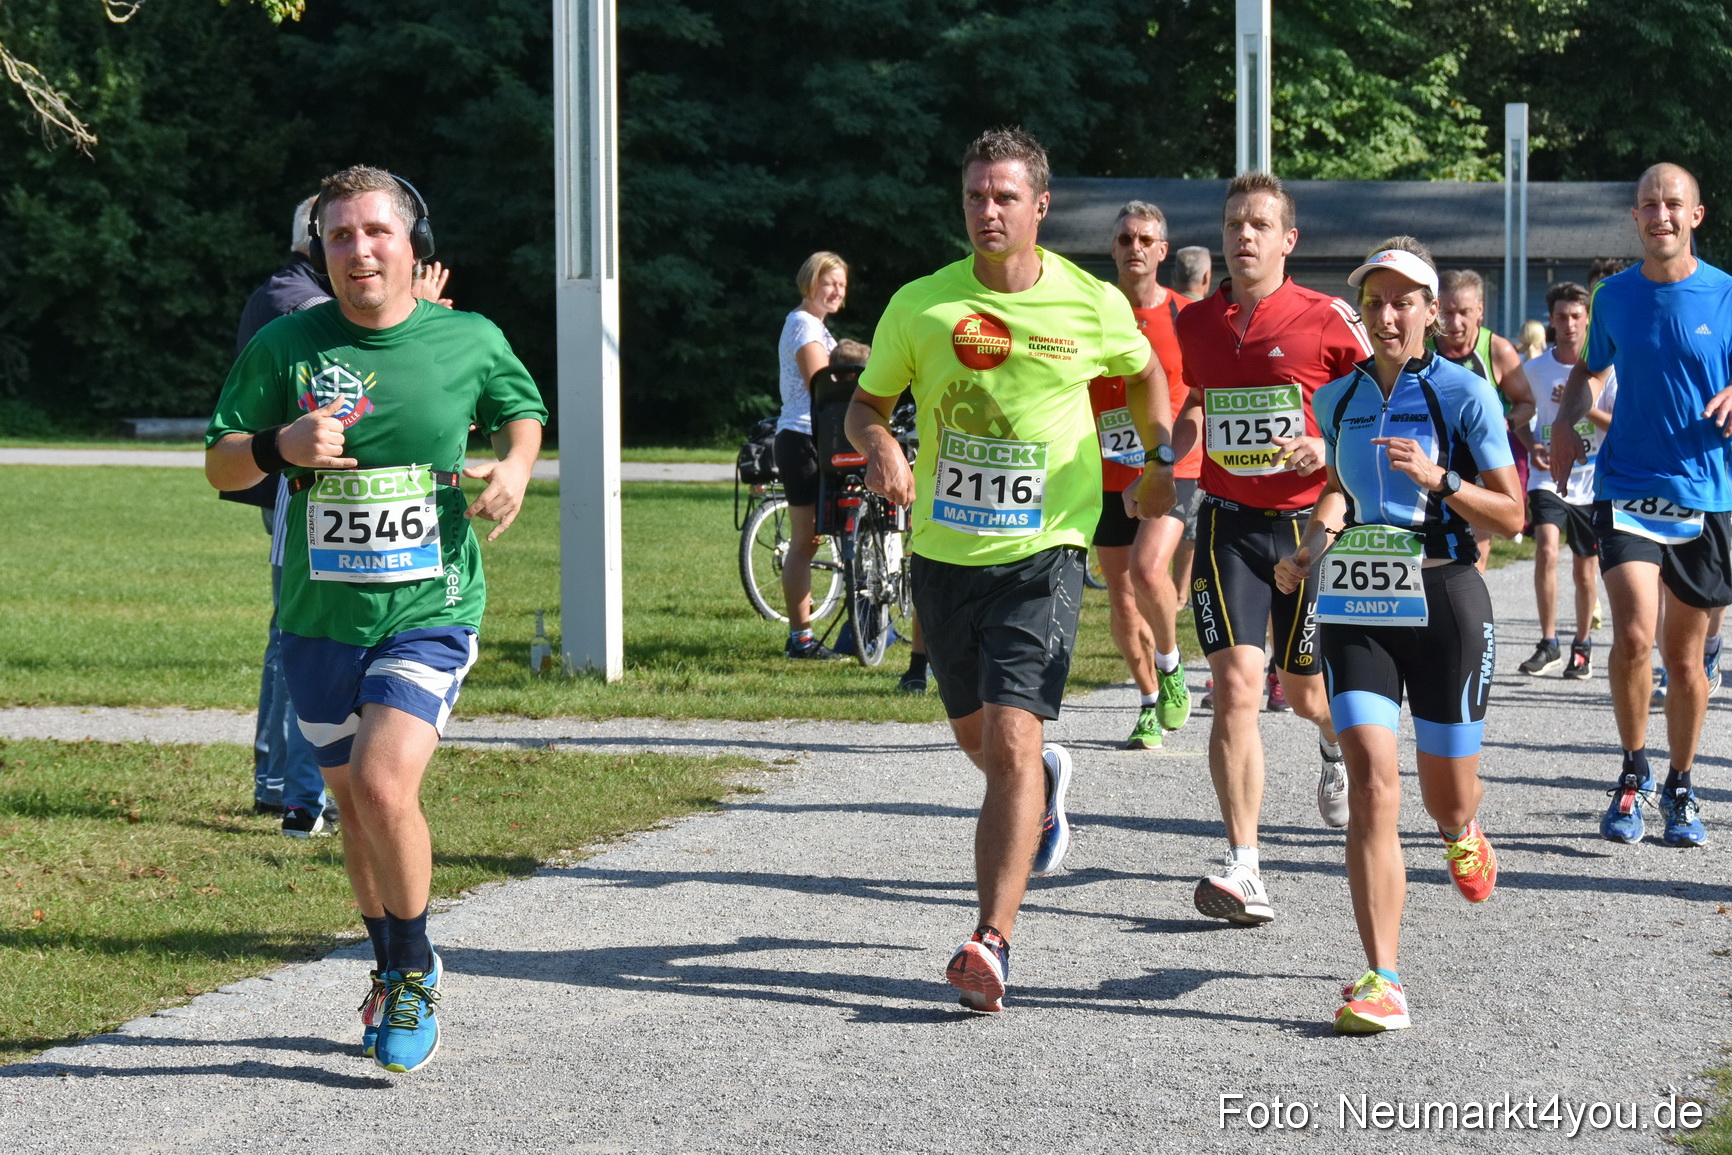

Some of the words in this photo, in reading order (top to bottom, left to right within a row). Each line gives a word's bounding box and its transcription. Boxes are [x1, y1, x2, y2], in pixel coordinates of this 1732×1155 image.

[956, 336, 1009, 346] URBANIAN
[1028, 335, 1075, 347] NEUMARKTER
[1028, 343, 1079, 355] ELEMENTELAUF
[1034, 352, 1061, 360] SEPTEMBER
[1212, 388, 1295, 412] BOCK
[1219, 416, 1293, 446] 1252
[946, 435, 1038, 467] BOCK
[317, 471, 426, 499] BOCK
[946, 467, 1033, 504] 2116
[323, 506, 424, 545] 2546
[944, 506, 1029, 526] MATTHIAS
[1333, 529, 1413, 553] BOCK
[338, 552, 413, 570] RAINER
[1332, 560, 1412, 591] 2652
[1197, 591, 1219, 644] SKINS
[1344, 601, 1400, 614] SANDY
